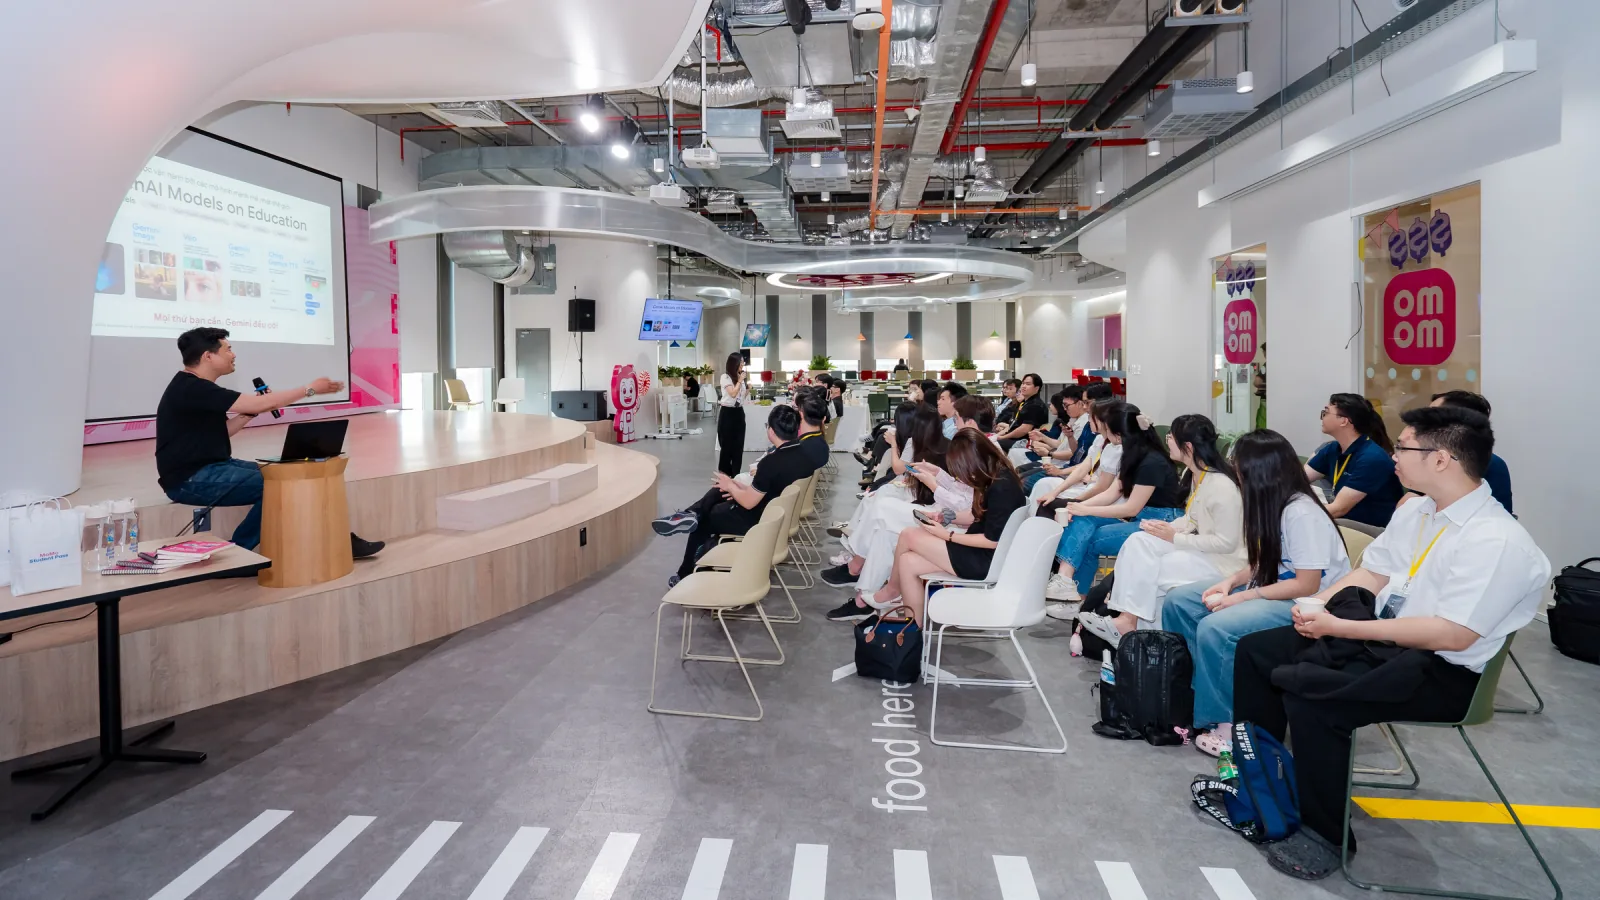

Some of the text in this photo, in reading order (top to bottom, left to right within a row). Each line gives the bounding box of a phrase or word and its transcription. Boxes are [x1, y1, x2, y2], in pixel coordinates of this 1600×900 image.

[132, 180, 163, 197] nAI
[168, 184, 223, 211] Models
[227, 203, 244, 217] on
[248, 205, 308, 232] Education
[29, 556, 54, 564] Student
[872, 738, 928, 813] food
[1208, 781, 1238, 797] SINCE
